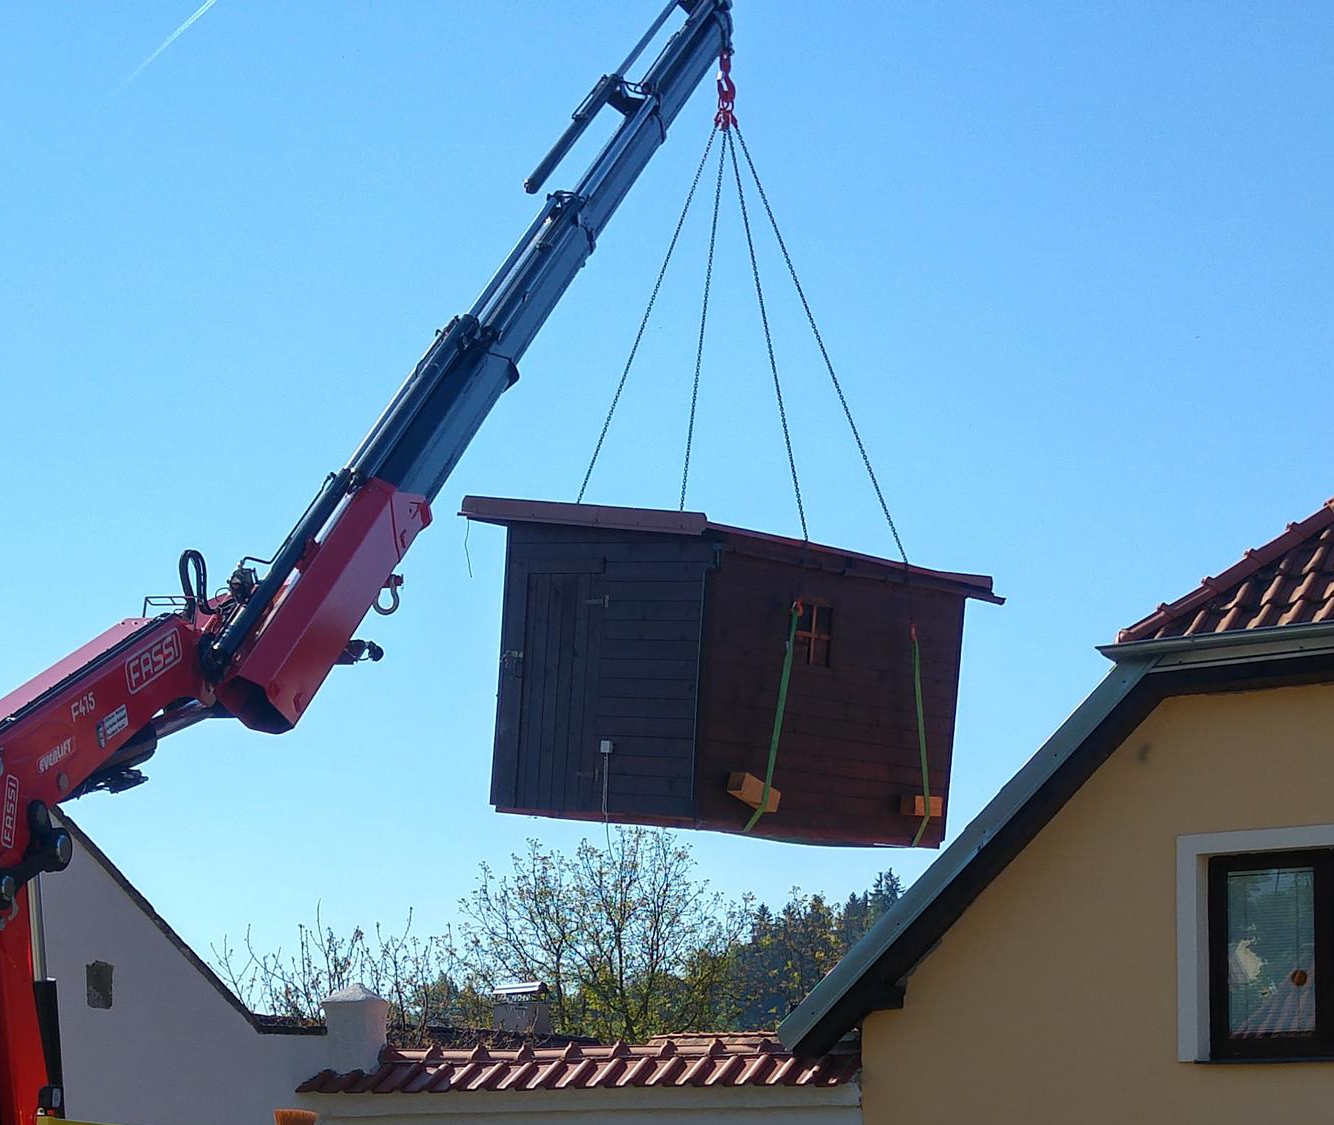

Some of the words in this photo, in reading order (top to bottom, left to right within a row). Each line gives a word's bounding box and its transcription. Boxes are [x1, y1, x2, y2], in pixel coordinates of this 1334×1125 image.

[128, 633, 179, 688] FASSI
[70, 692, 96, 722] F415
[3, 780, 17, 842] FASSI
